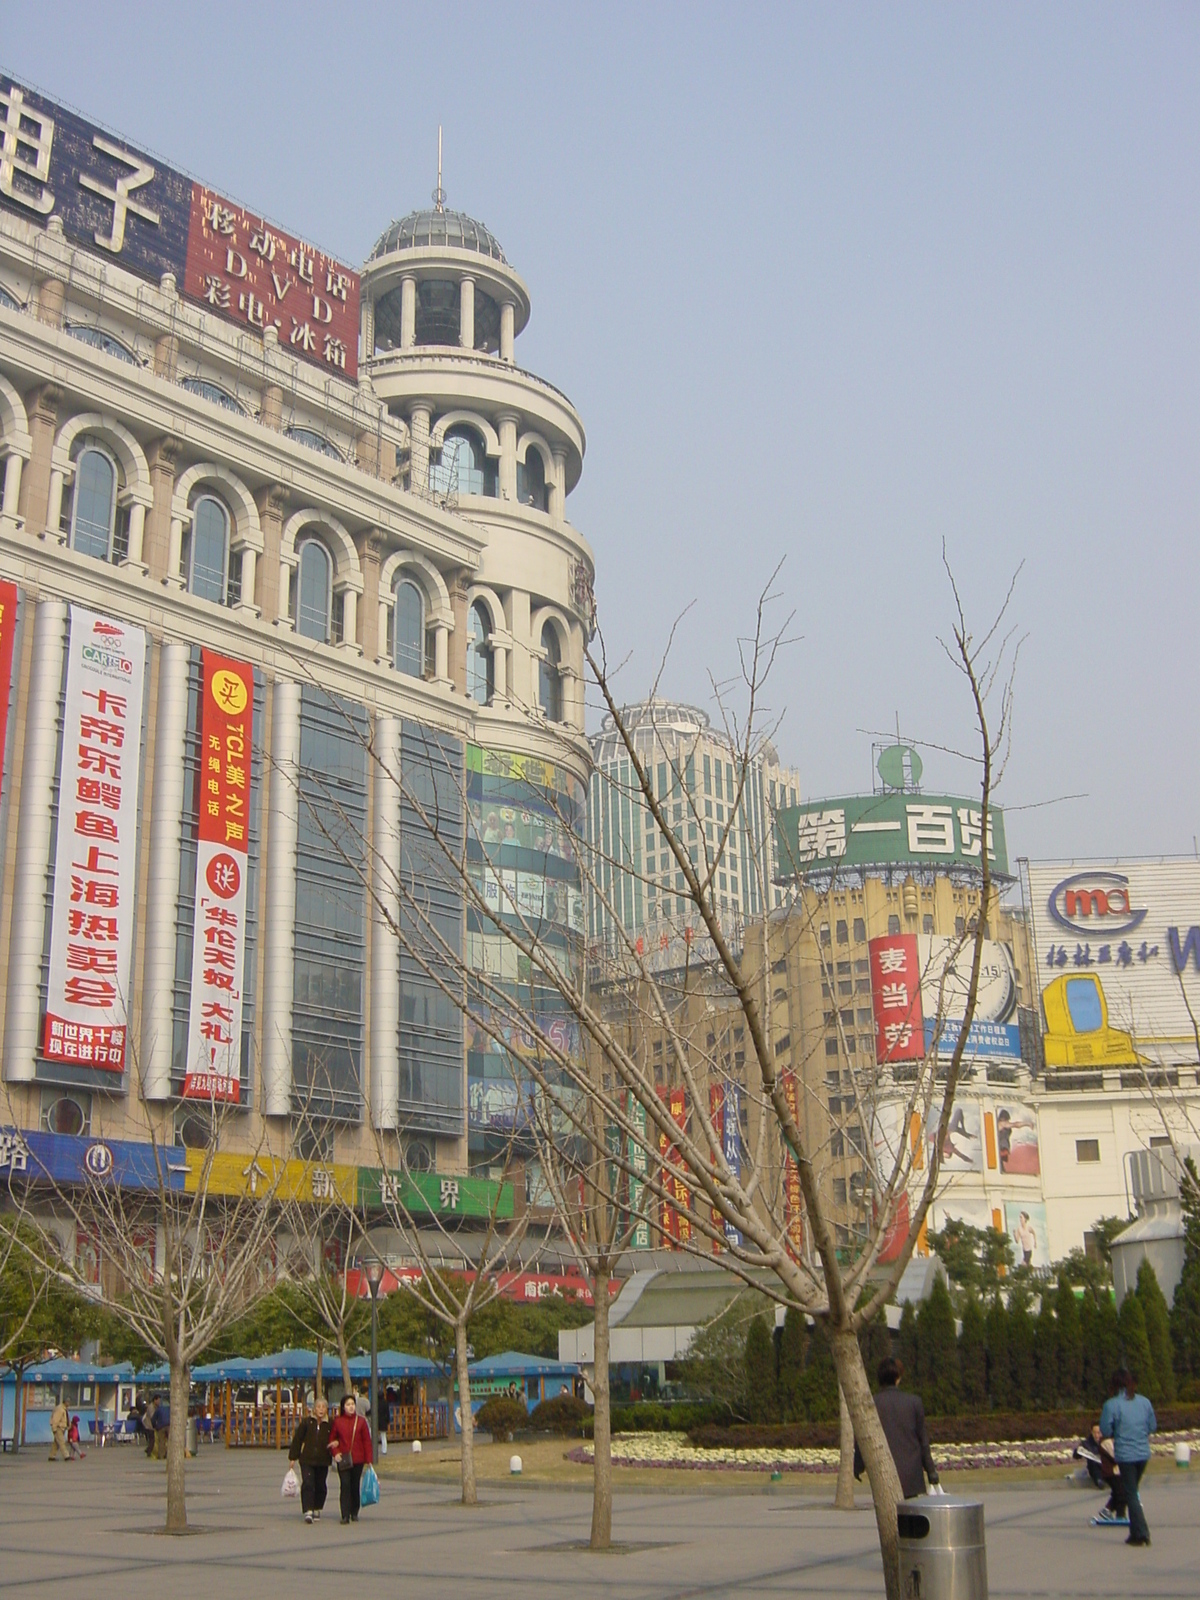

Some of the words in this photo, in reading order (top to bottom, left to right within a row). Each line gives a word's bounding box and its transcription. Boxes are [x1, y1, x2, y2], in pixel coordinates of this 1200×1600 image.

[208, 202, 349, 301] 移动电话
[207, 734, 221, 817] 无绳电话
[798, 804, 997, 863] 第一百货
[214, 861, 236, 892] 送
[879, 947, 913, 1049] 麦当劳
[49, 1037, 122, 1063] 现在进行中
